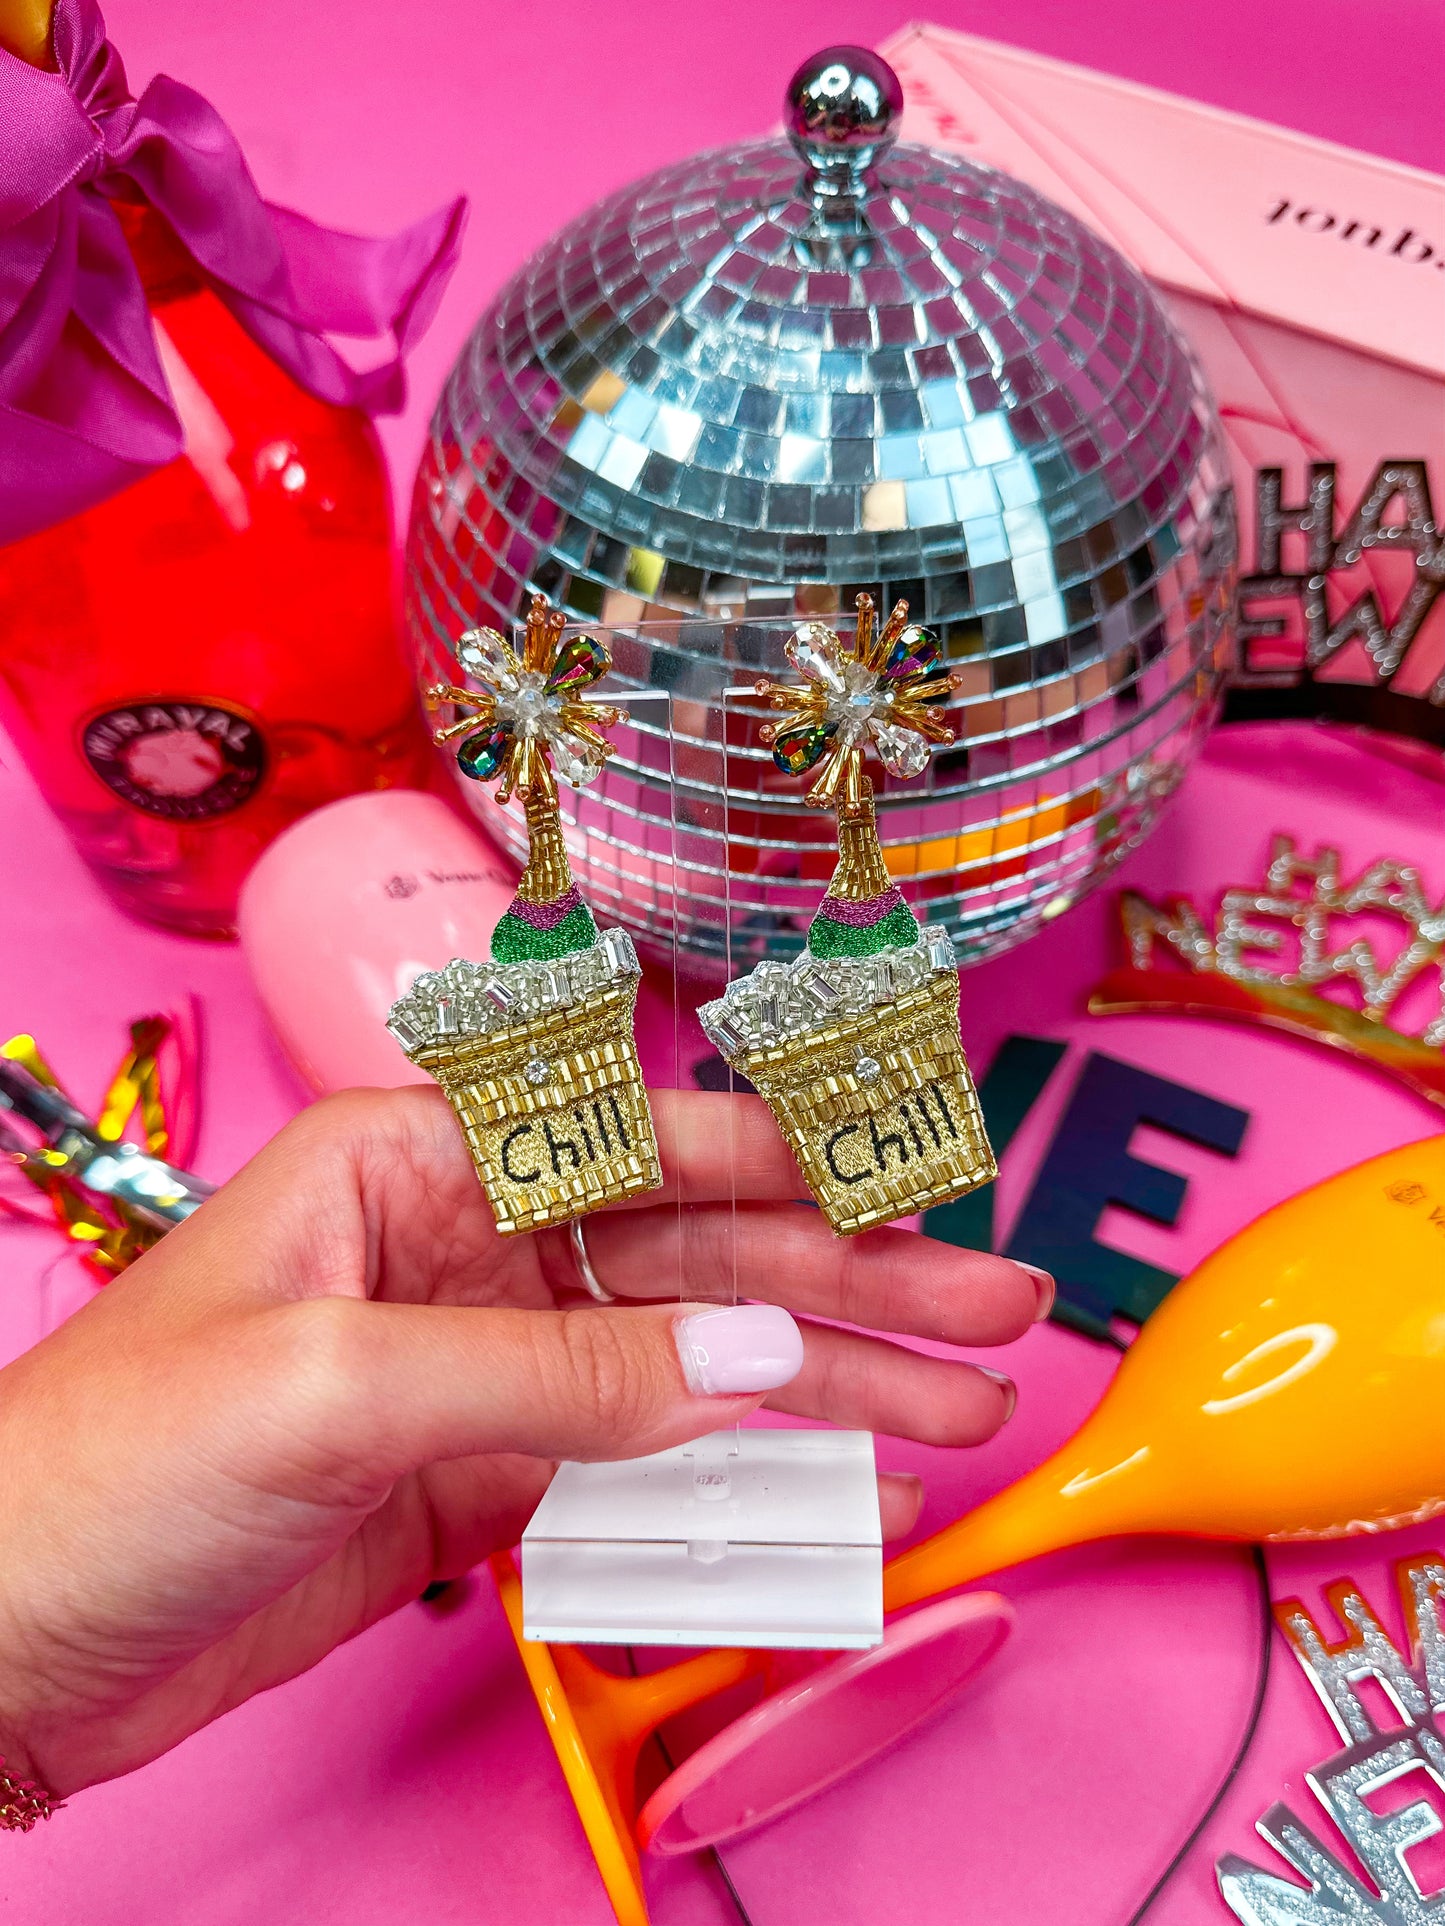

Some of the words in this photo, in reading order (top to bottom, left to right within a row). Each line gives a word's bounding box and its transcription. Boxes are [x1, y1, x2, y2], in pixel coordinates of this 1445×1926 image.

[1256, 459, 1445, 584] HA
[86, 704, 252, 762] MIRAVAL
[1266, 834, 1442, 938] HA
[501, 1092, 631, 1183] Chill
[825, 1083, 959, 1185] Chill
